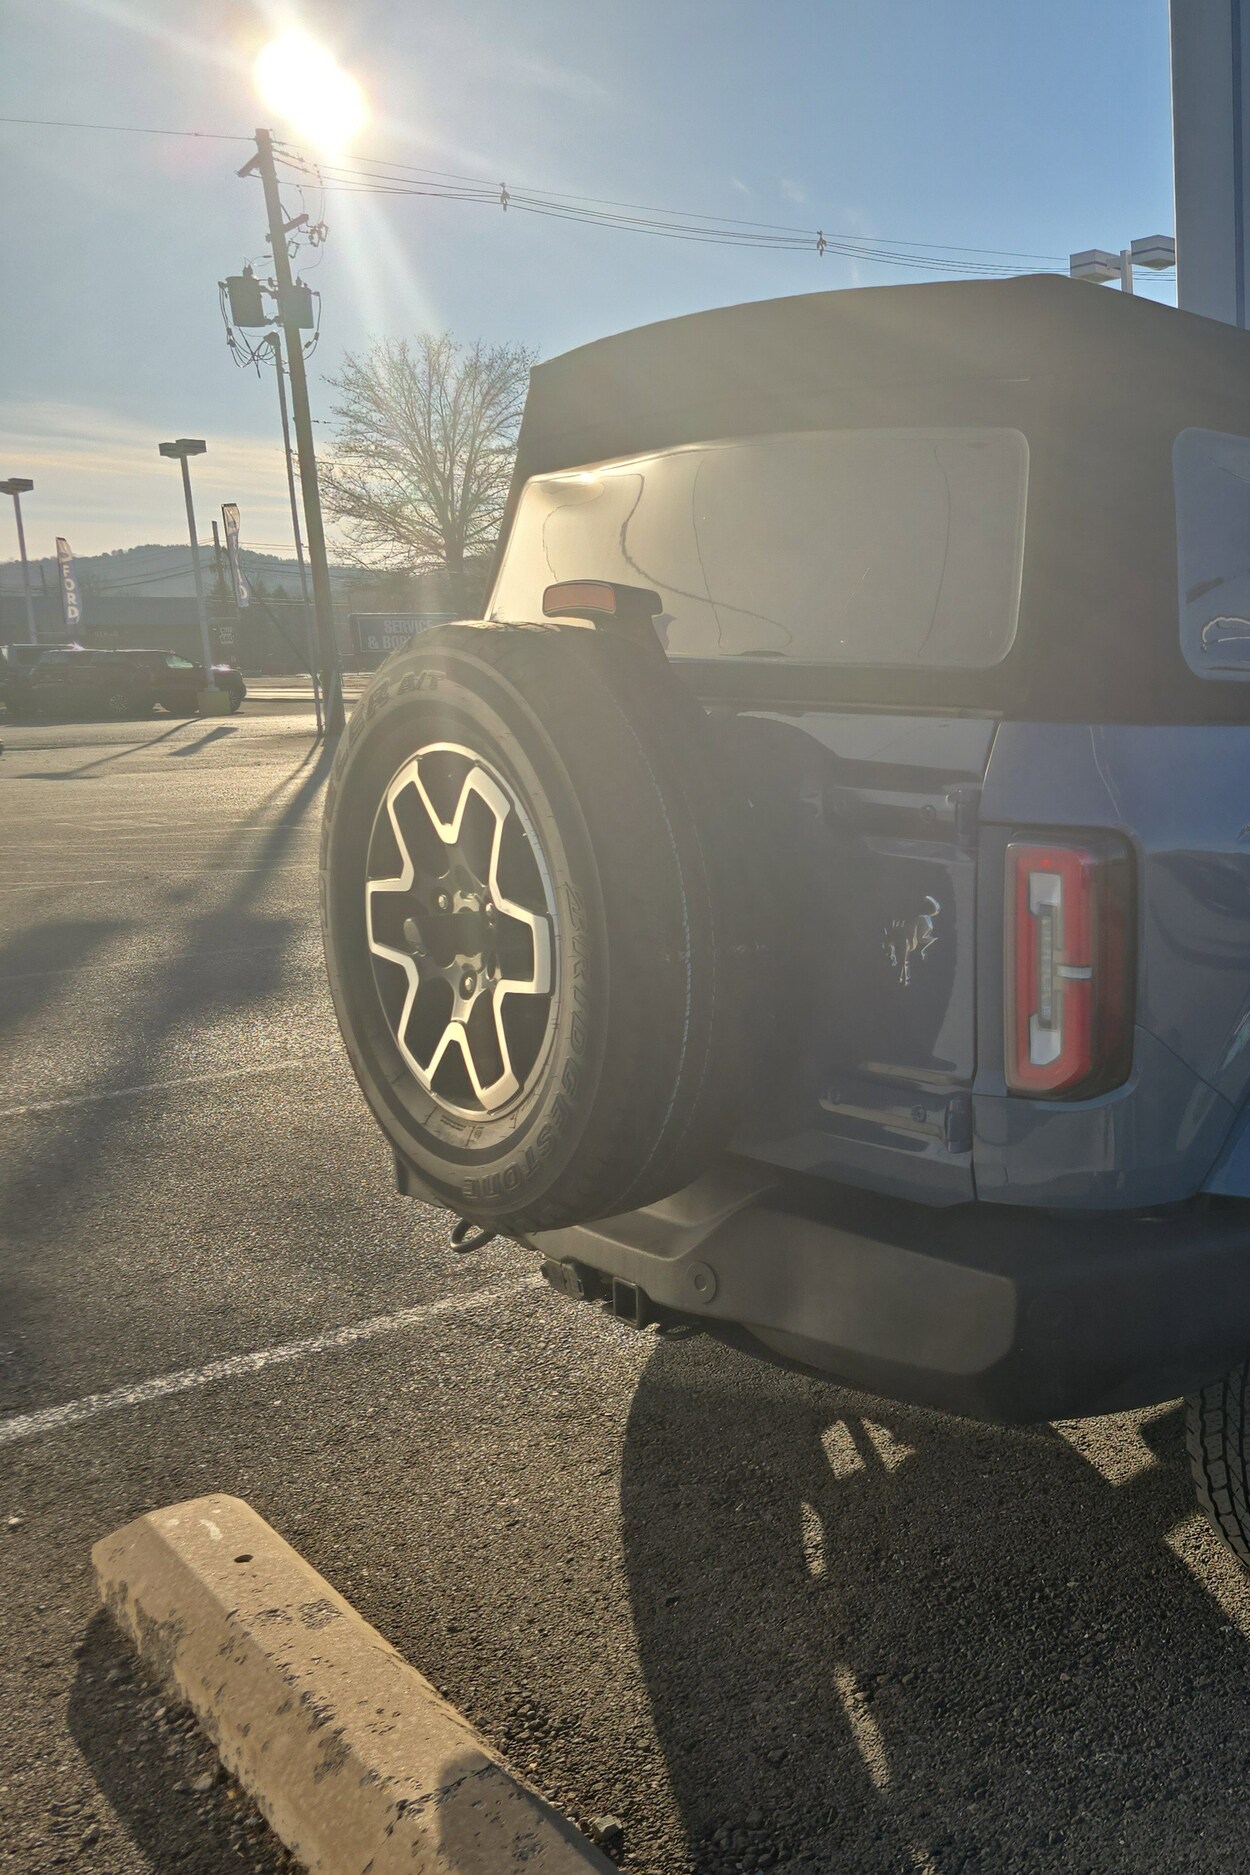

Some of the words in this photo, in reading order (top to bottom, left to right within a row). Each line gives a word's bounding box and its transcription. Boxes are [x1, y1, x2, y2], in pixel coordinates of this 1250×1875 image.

[62, 564, 79, 619] FORD
[367, 635, 380, 650] &
[463, 880, 591, 1200] BRIDGESTONE
